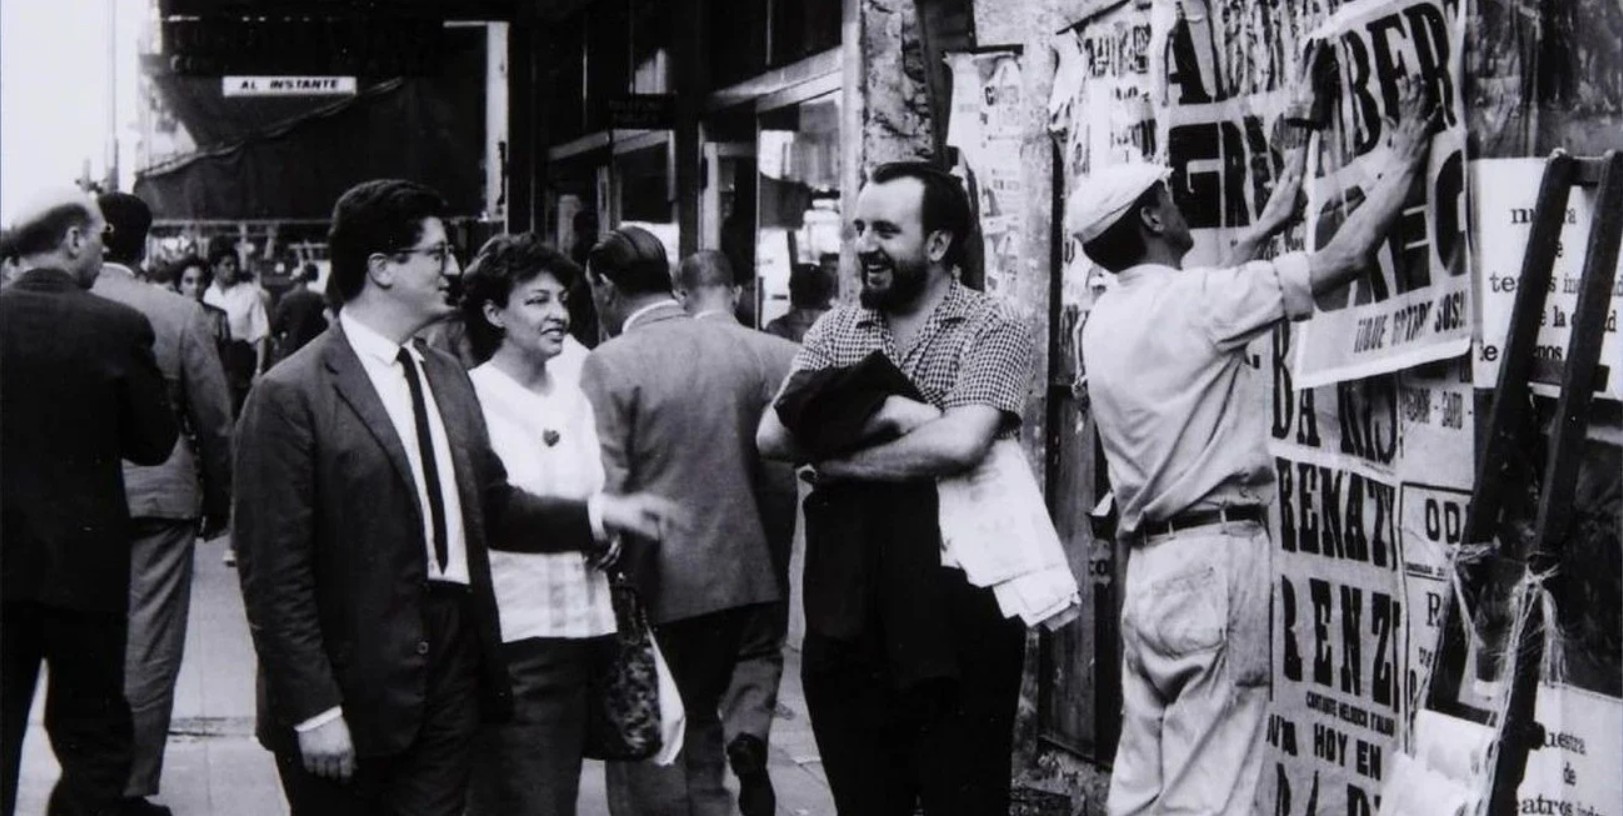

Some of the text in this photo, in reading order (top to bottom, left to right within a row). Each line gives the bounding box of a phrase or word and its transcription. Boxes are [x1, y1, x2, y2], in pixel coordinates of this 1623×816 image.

[241, 79, 338, 90] AL INSTANTE
[1425, 497, 1470, 545] OD
[1314, 722, 1348, 767] HOY
[1356, 738, 1382, 781] EN
